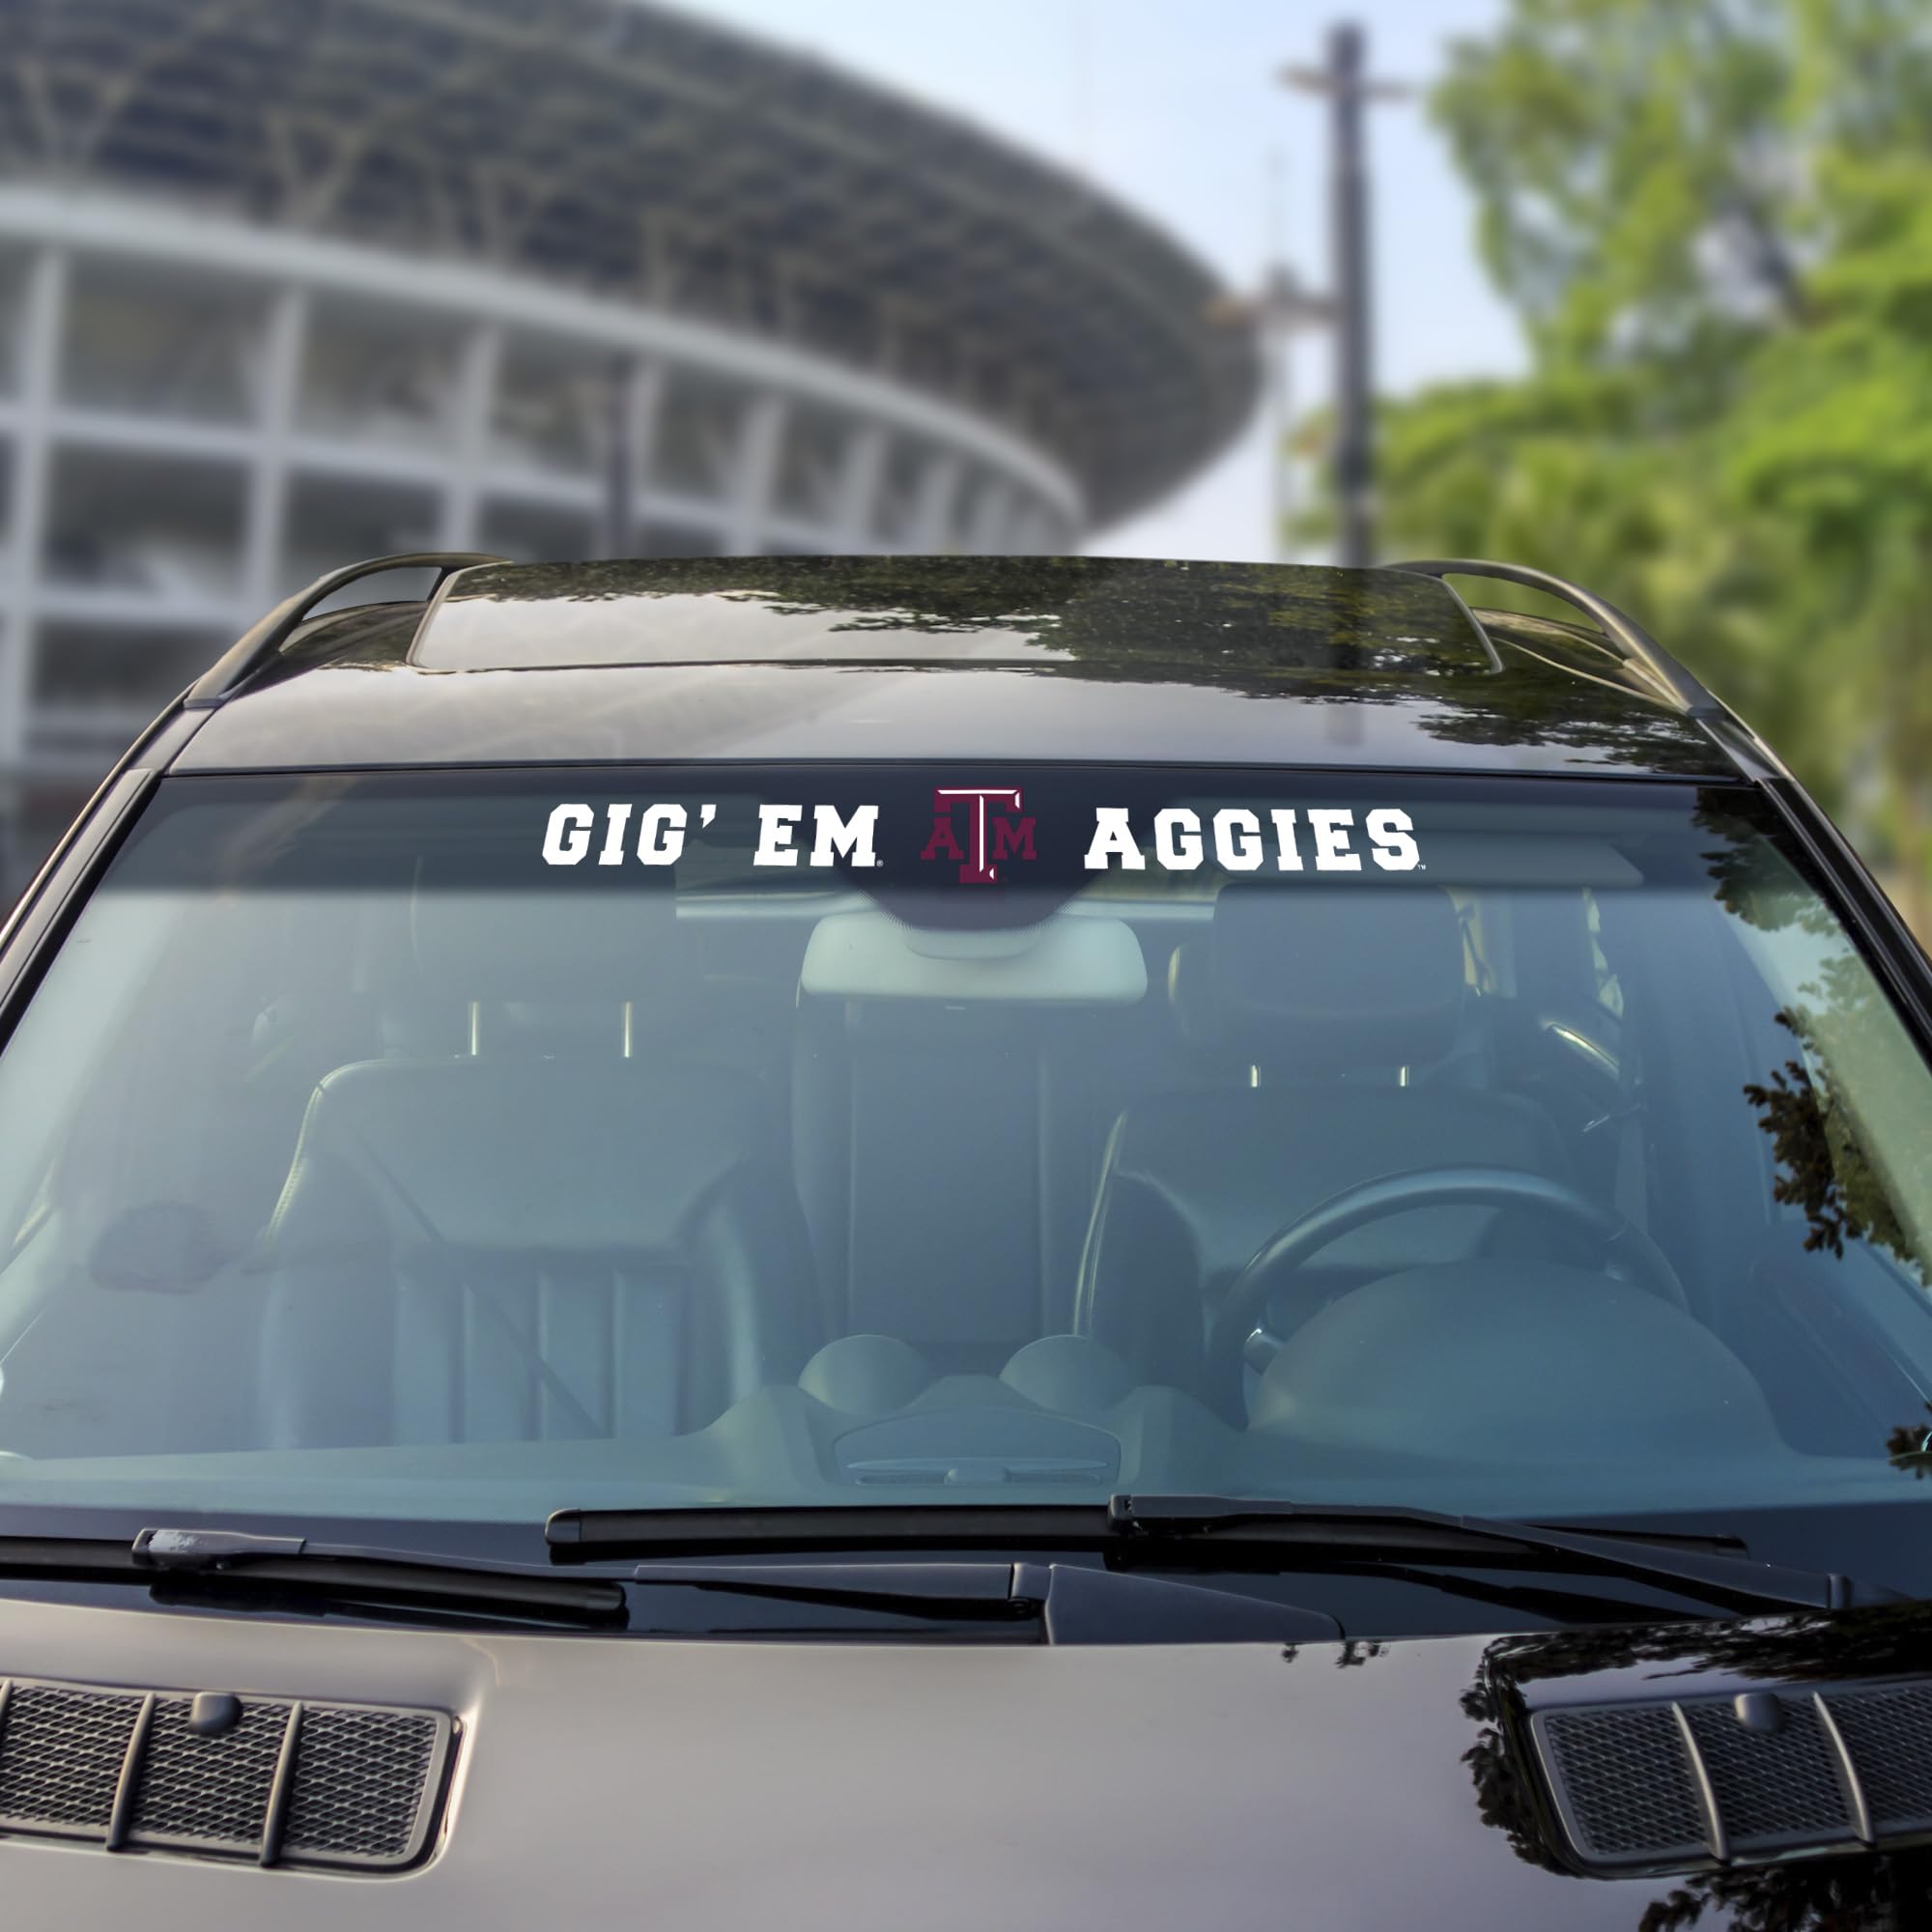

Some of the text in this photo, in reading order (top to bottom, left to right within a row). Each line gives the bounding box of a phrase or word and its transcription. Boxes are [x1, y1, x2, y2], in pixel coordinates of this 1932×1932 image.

[542, 803, 717, 866] GIG'
[753, 804, 879, 867] EM
[1084, 808, 1421, 871] AGGIES
